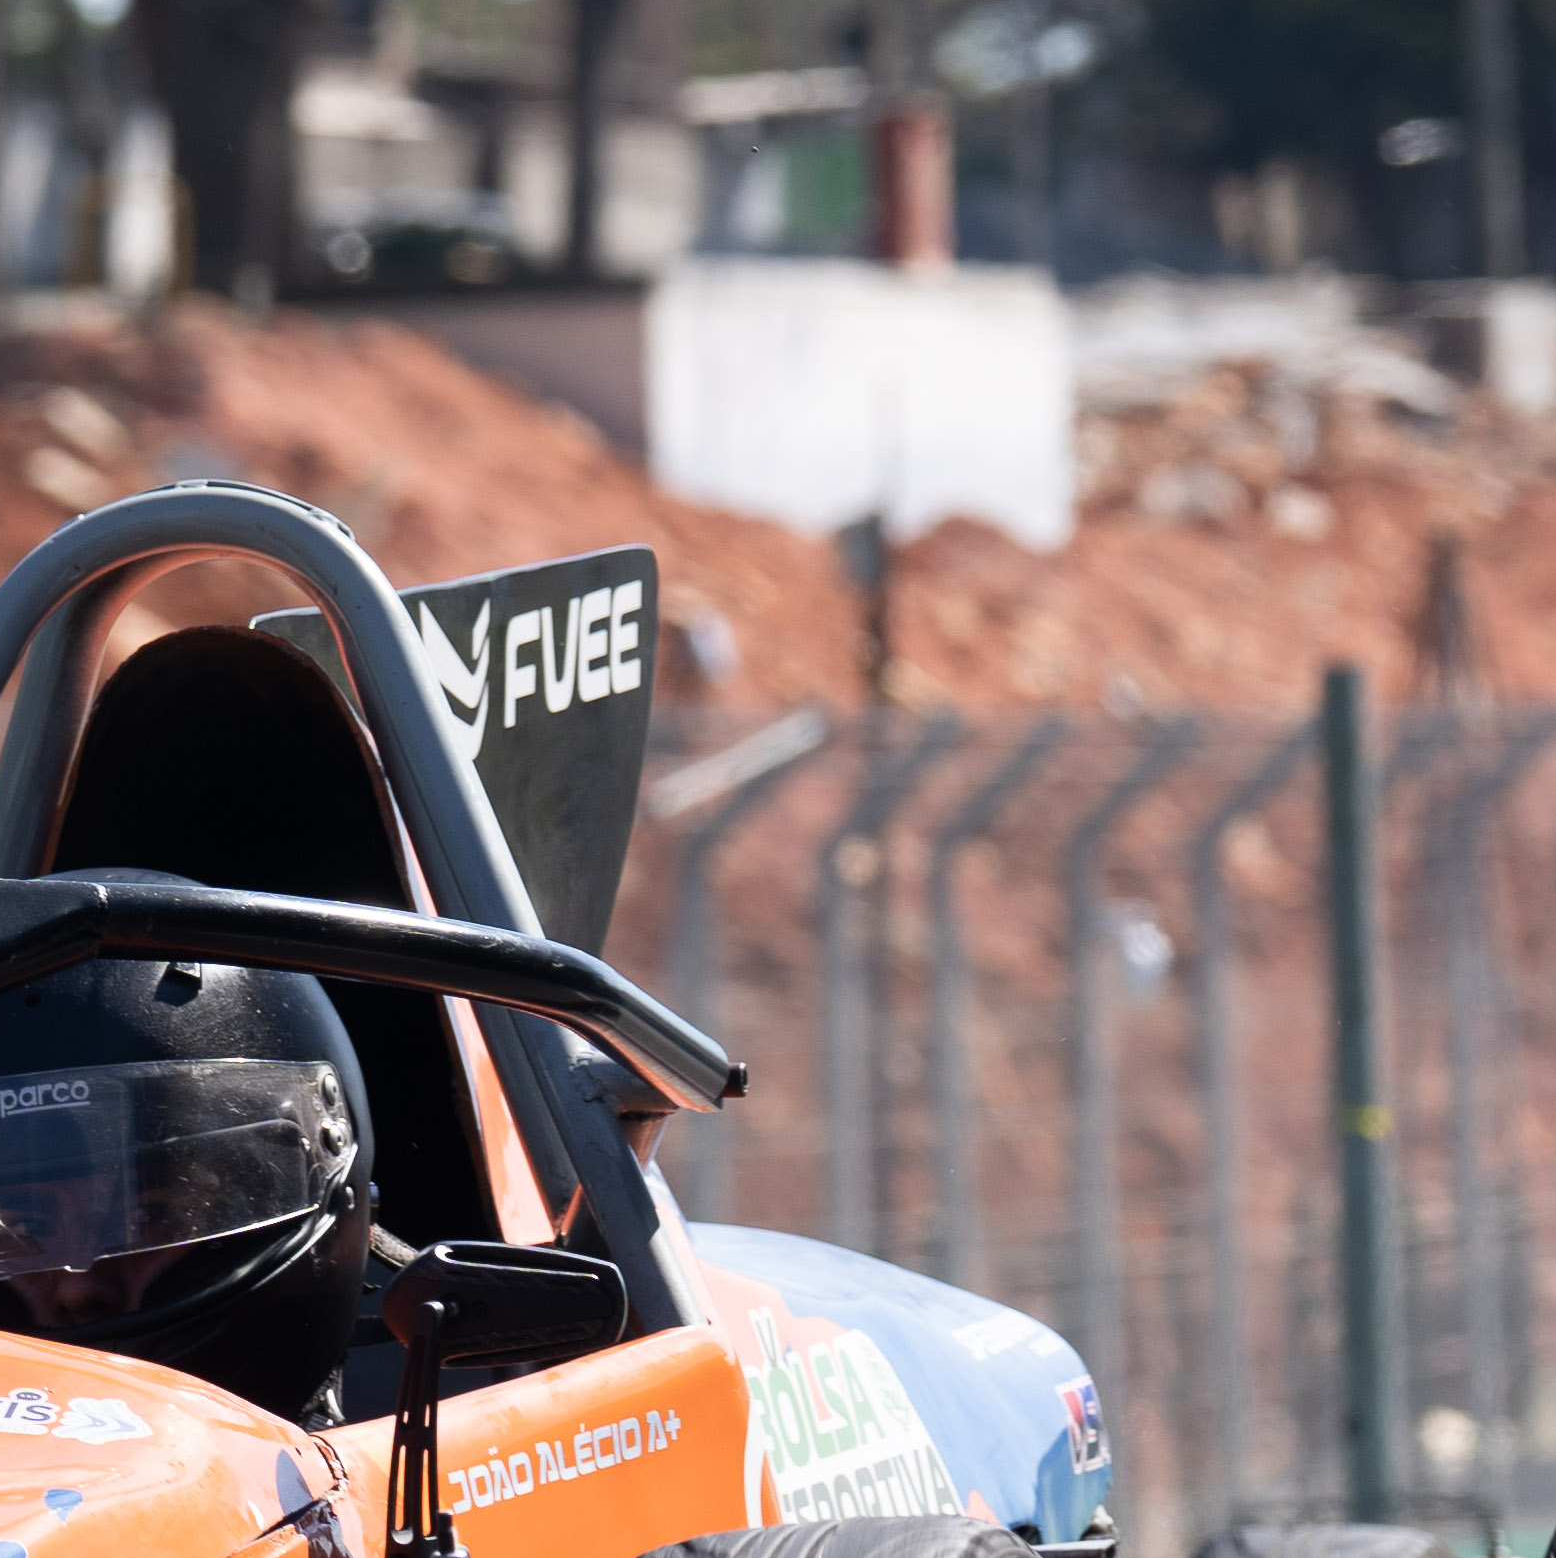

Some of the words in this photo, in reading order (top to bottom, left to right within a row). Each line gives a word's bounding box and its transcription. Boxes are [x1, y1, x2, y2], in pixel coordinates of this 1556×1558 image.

[447, 1446, 535, 1514] JOÃO
[534, 1423, 642, 1485] ALÉCIO
[645, 1409, 682, 1454] A+
